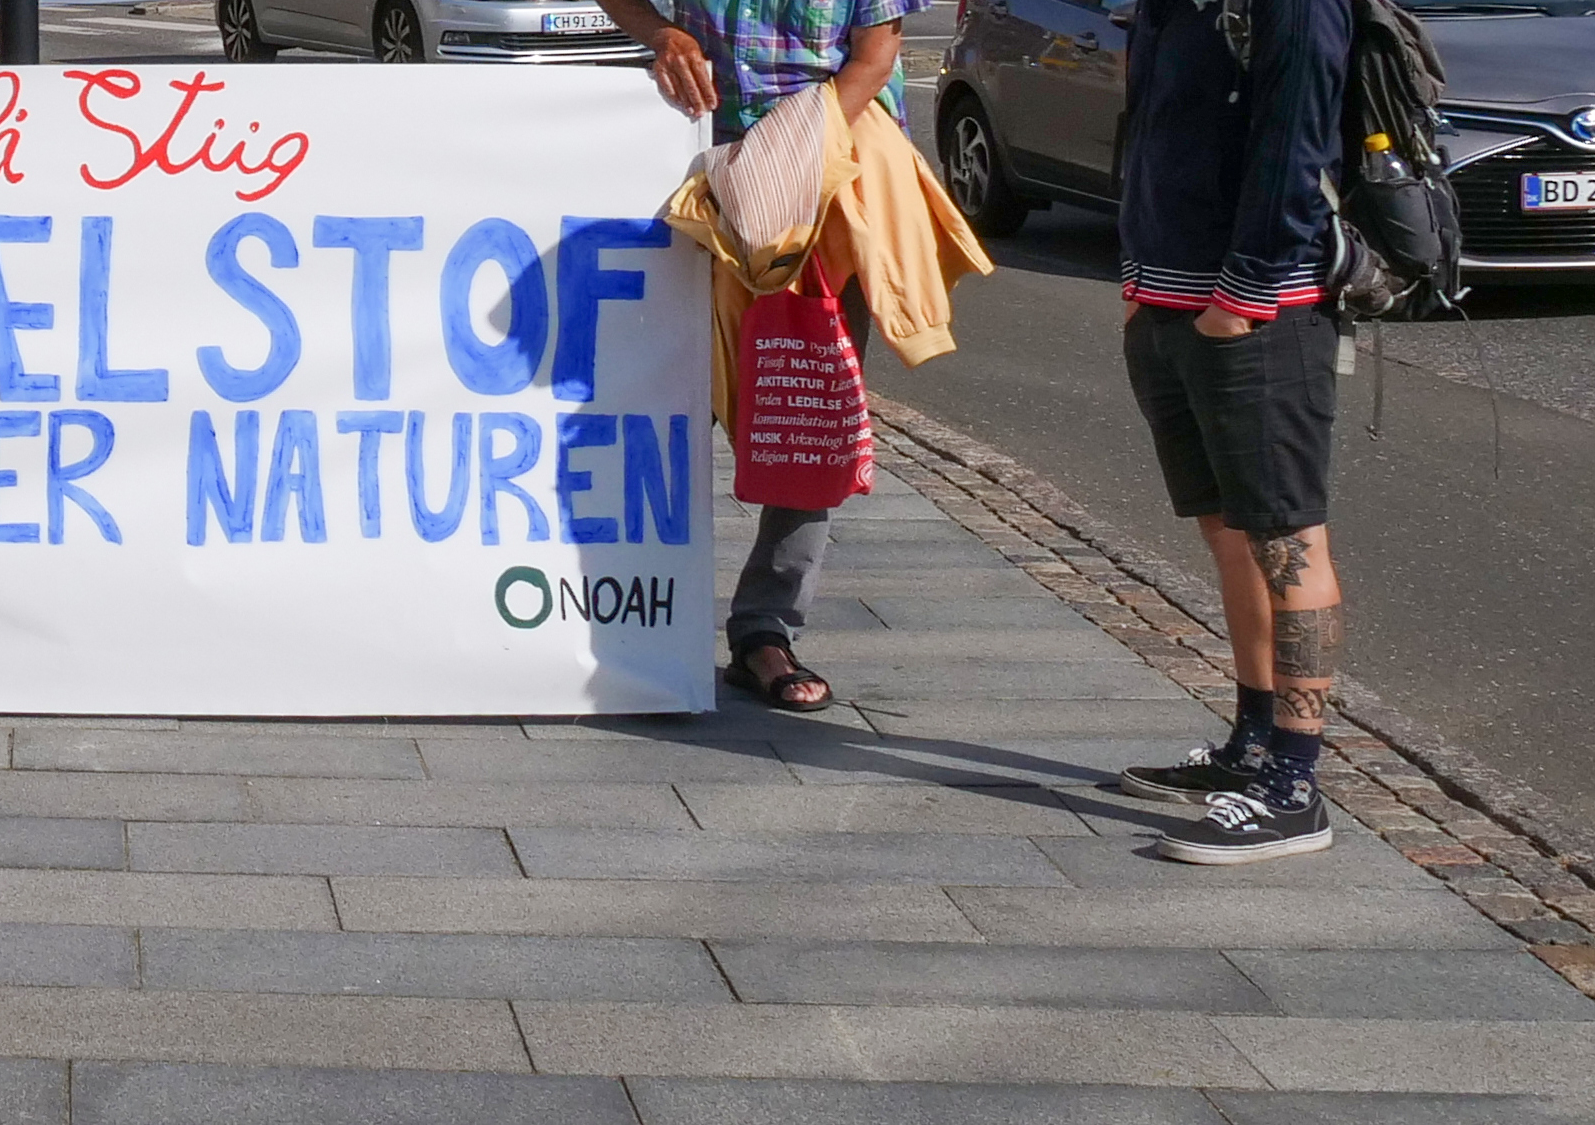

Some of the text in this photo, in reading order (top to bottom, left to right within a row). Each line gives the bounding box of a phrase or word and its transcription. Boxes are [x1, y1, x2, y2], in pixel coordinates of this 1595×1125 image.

[1544, 180, 1579, 203] BD
[790, 357, 835, 374] NATUR
[787, 395, 842, 411] LEDELSE
[750, 431, 782, 445] MUSIK
[751, 449, 789, 466] Religion
[792, 452, 821, 465] FILM
[186, 409, 690, 547] NATUREN
[560, 575, 674, 628] NOAH
